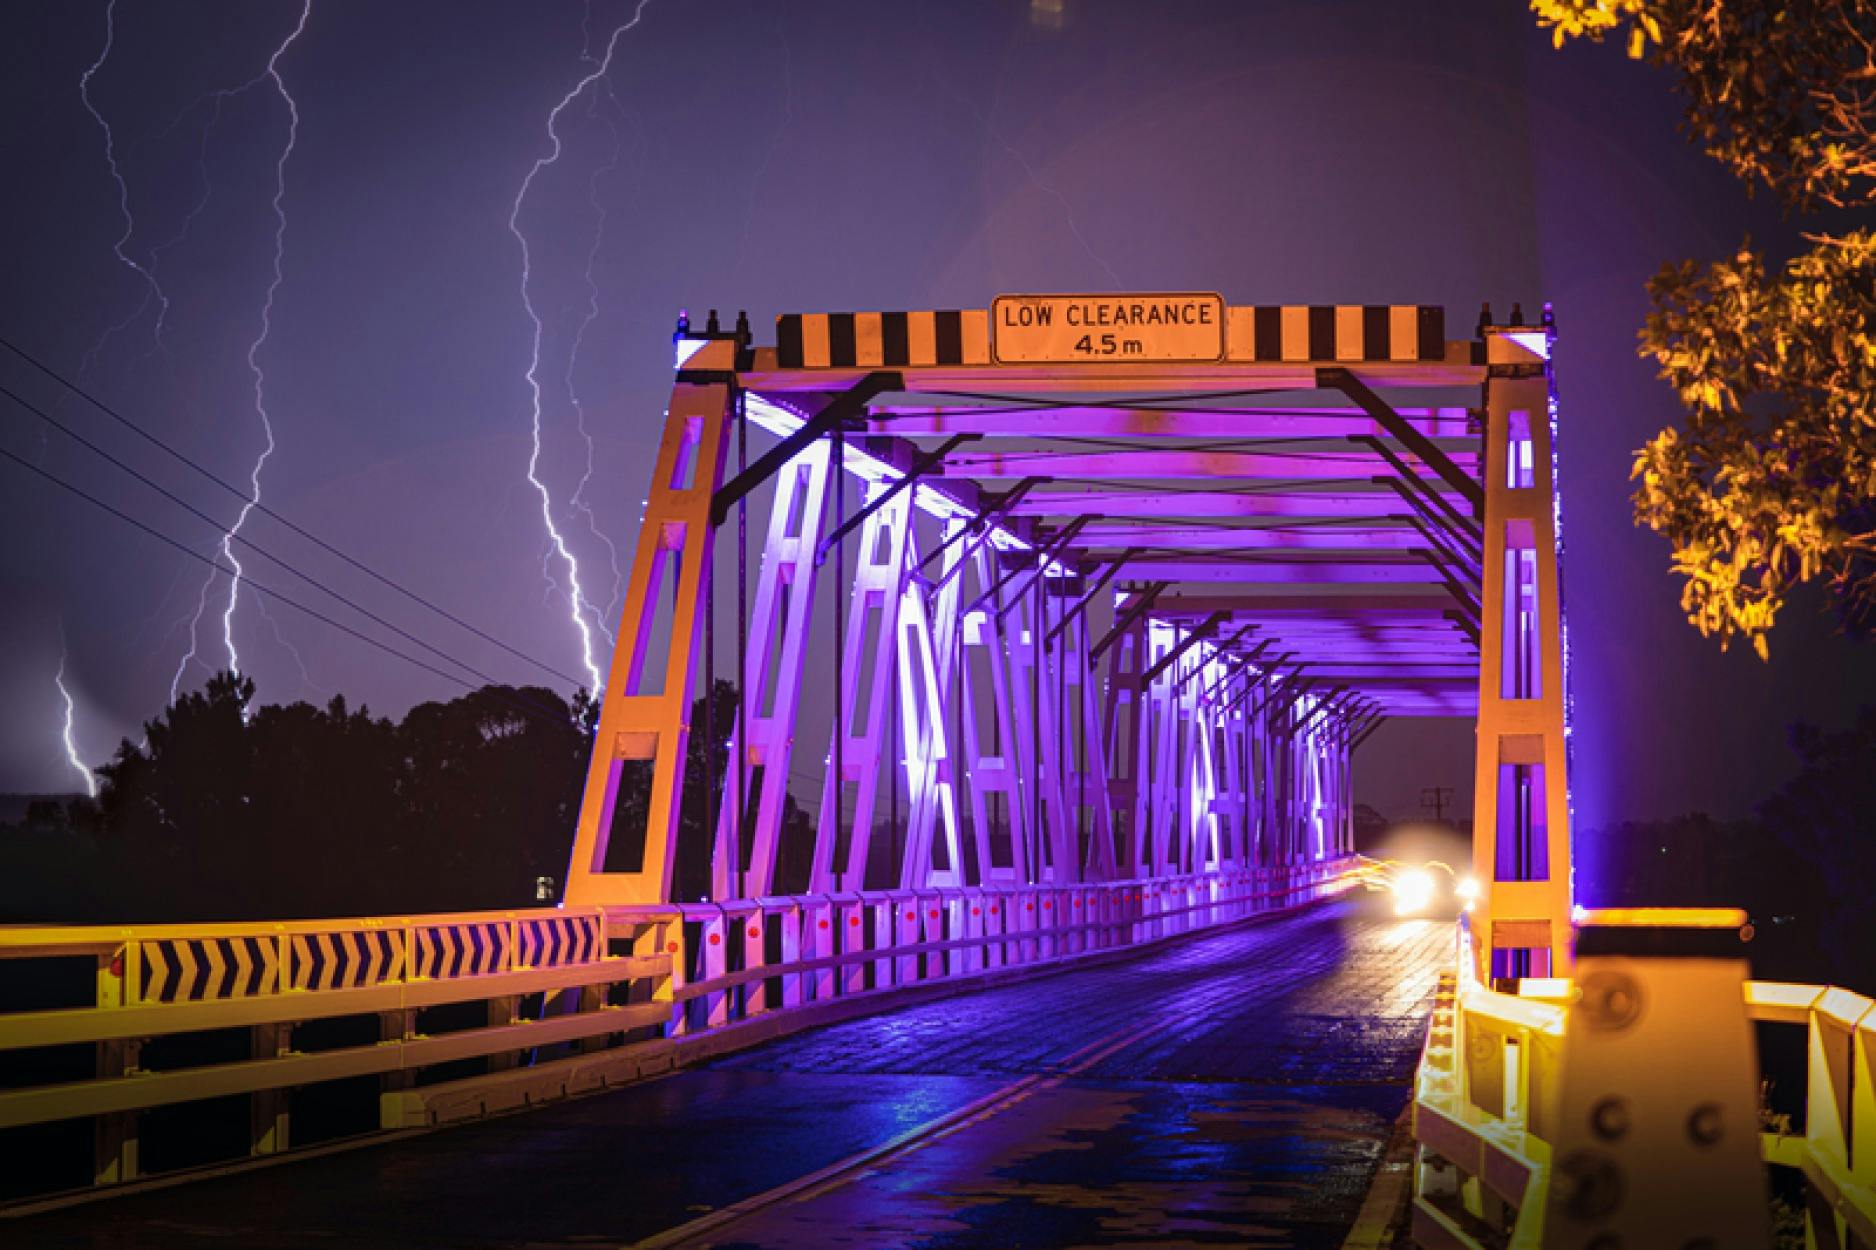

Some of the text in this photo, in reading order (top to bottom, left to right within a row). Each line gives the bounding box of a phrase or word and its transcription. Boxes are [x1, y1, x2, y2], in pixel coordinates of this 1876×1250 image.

[1004, 303, 1212, 327] LOW CLEARANCE
[1074, 333, 1143, 355] 4.5 m
